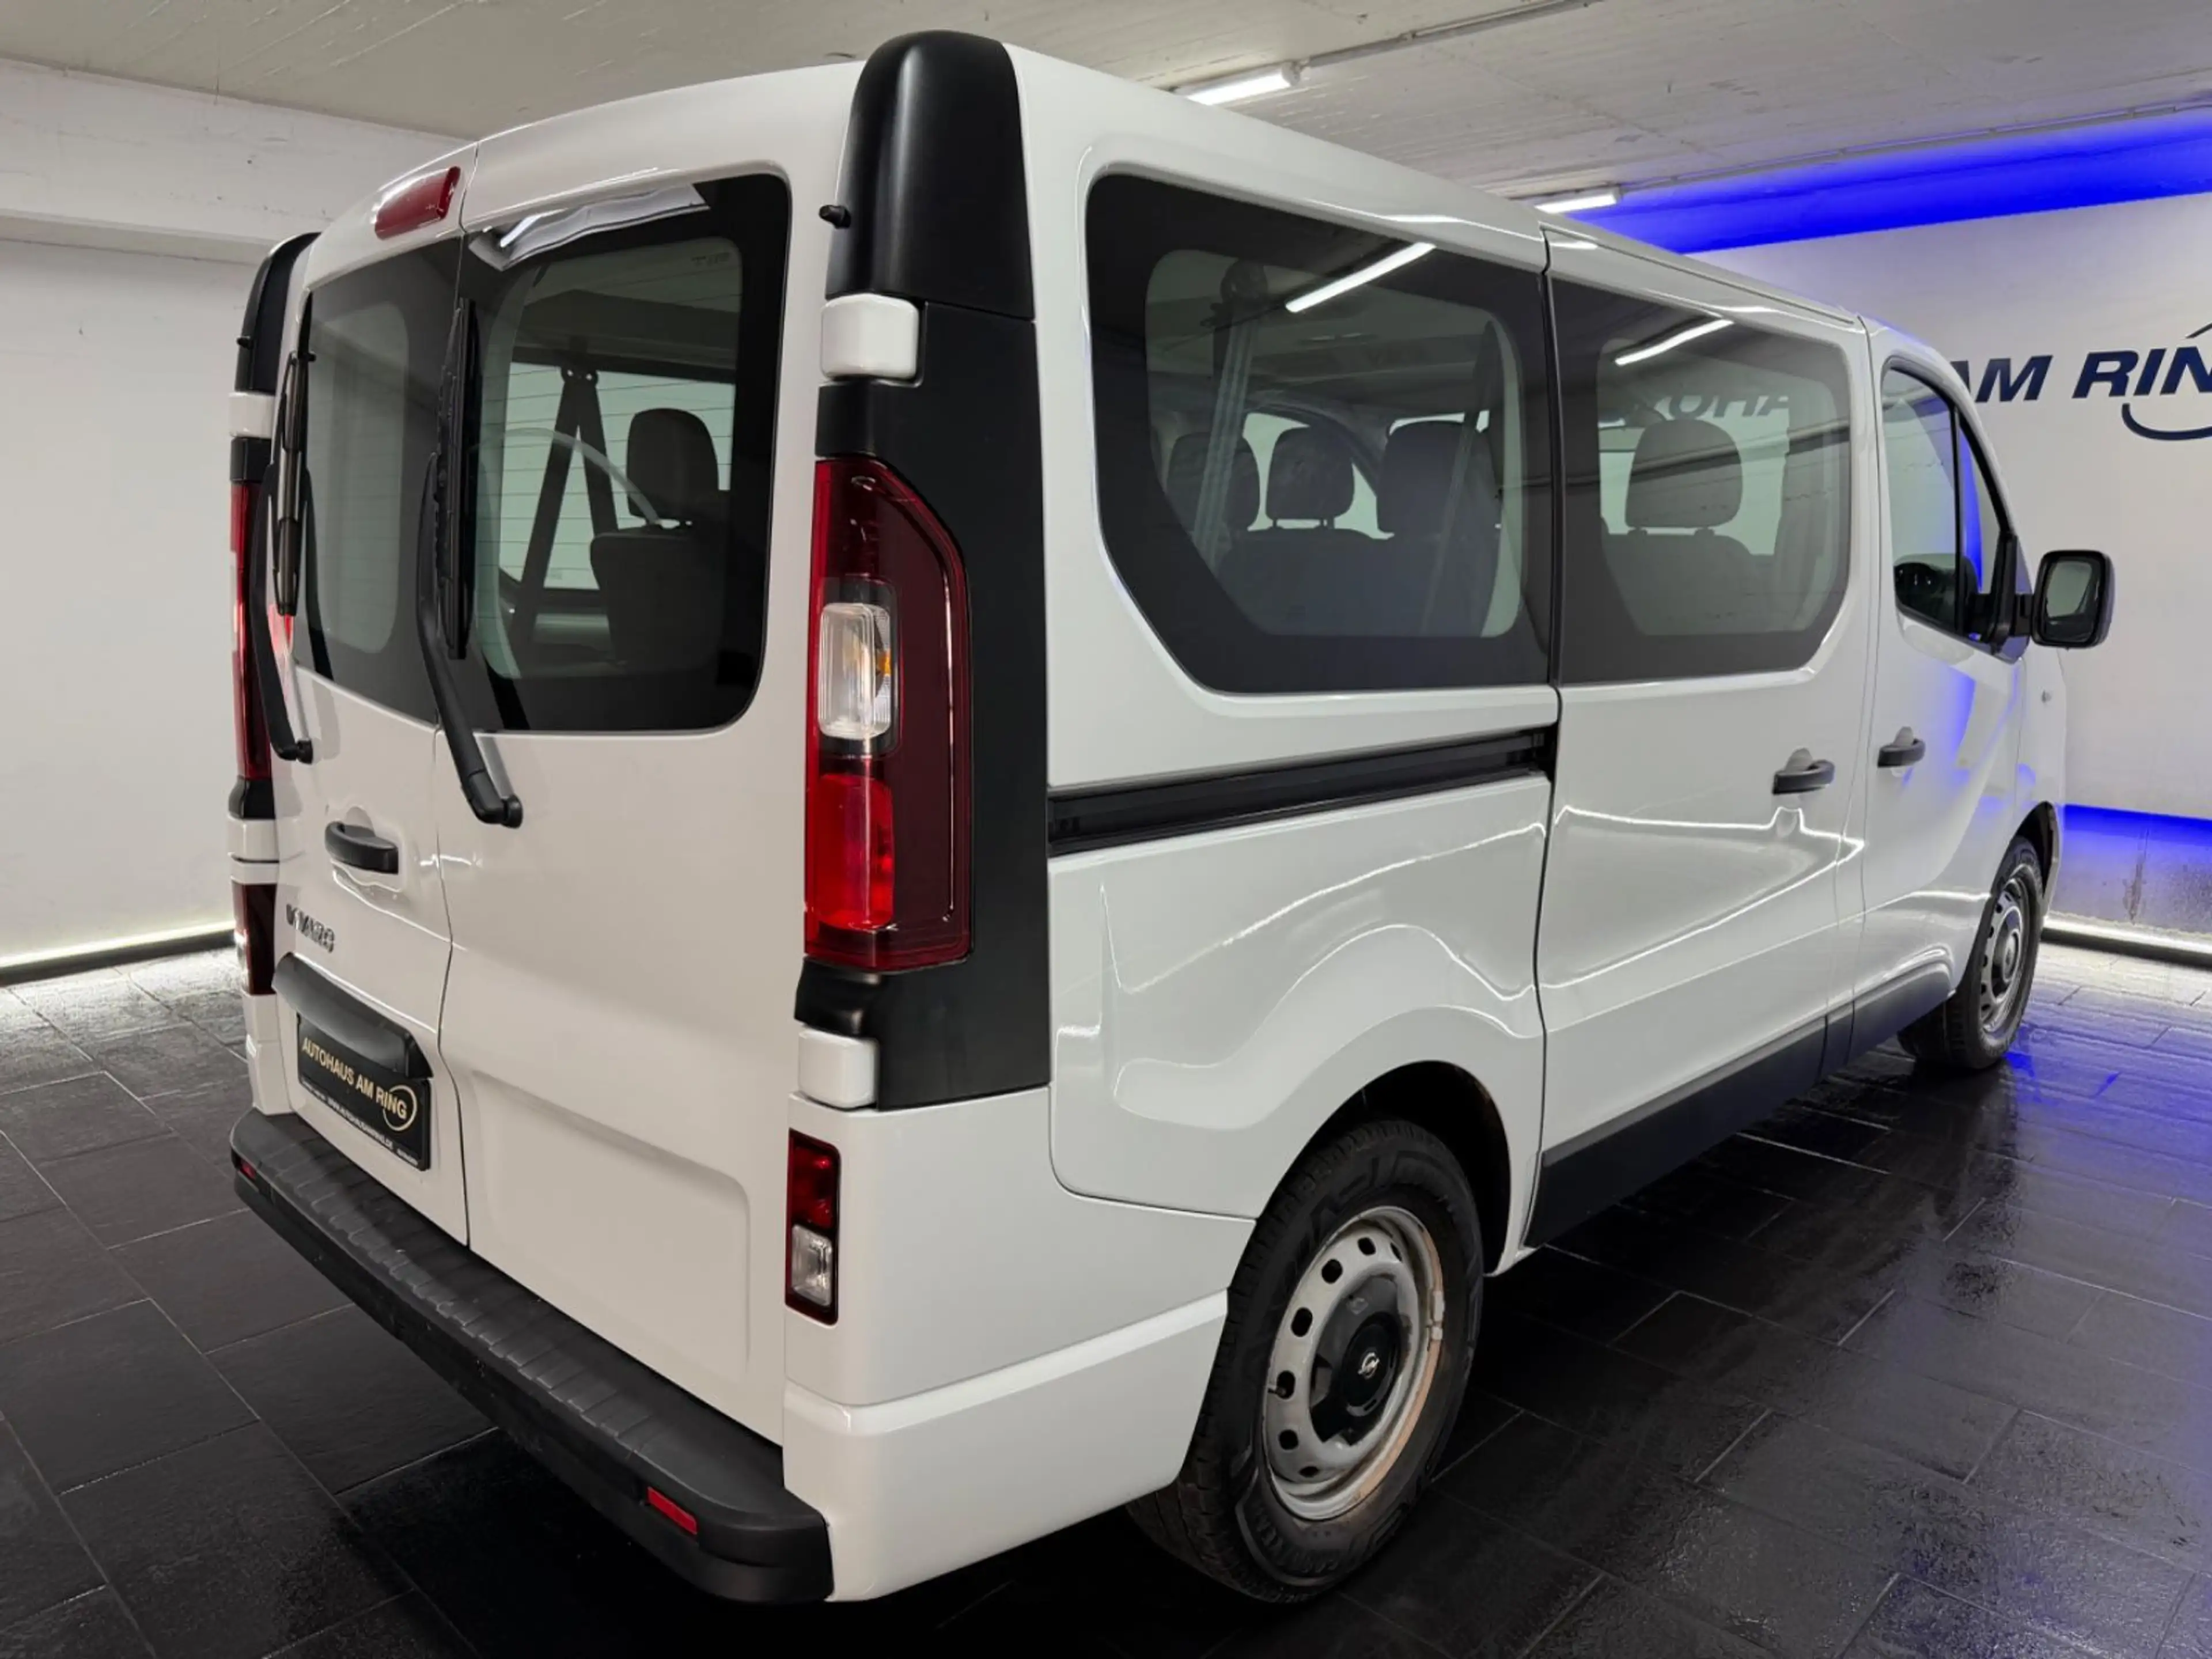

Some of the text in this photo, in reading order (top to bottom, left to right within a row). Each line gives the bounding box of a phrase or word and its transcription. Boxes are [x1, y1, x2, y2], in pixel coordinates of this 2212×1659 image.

[302, 1037, 355, 1085] AUTOHAUS
[355, 1074, 374, 1100] AM
[376, 1086, 407, 1120] RING
